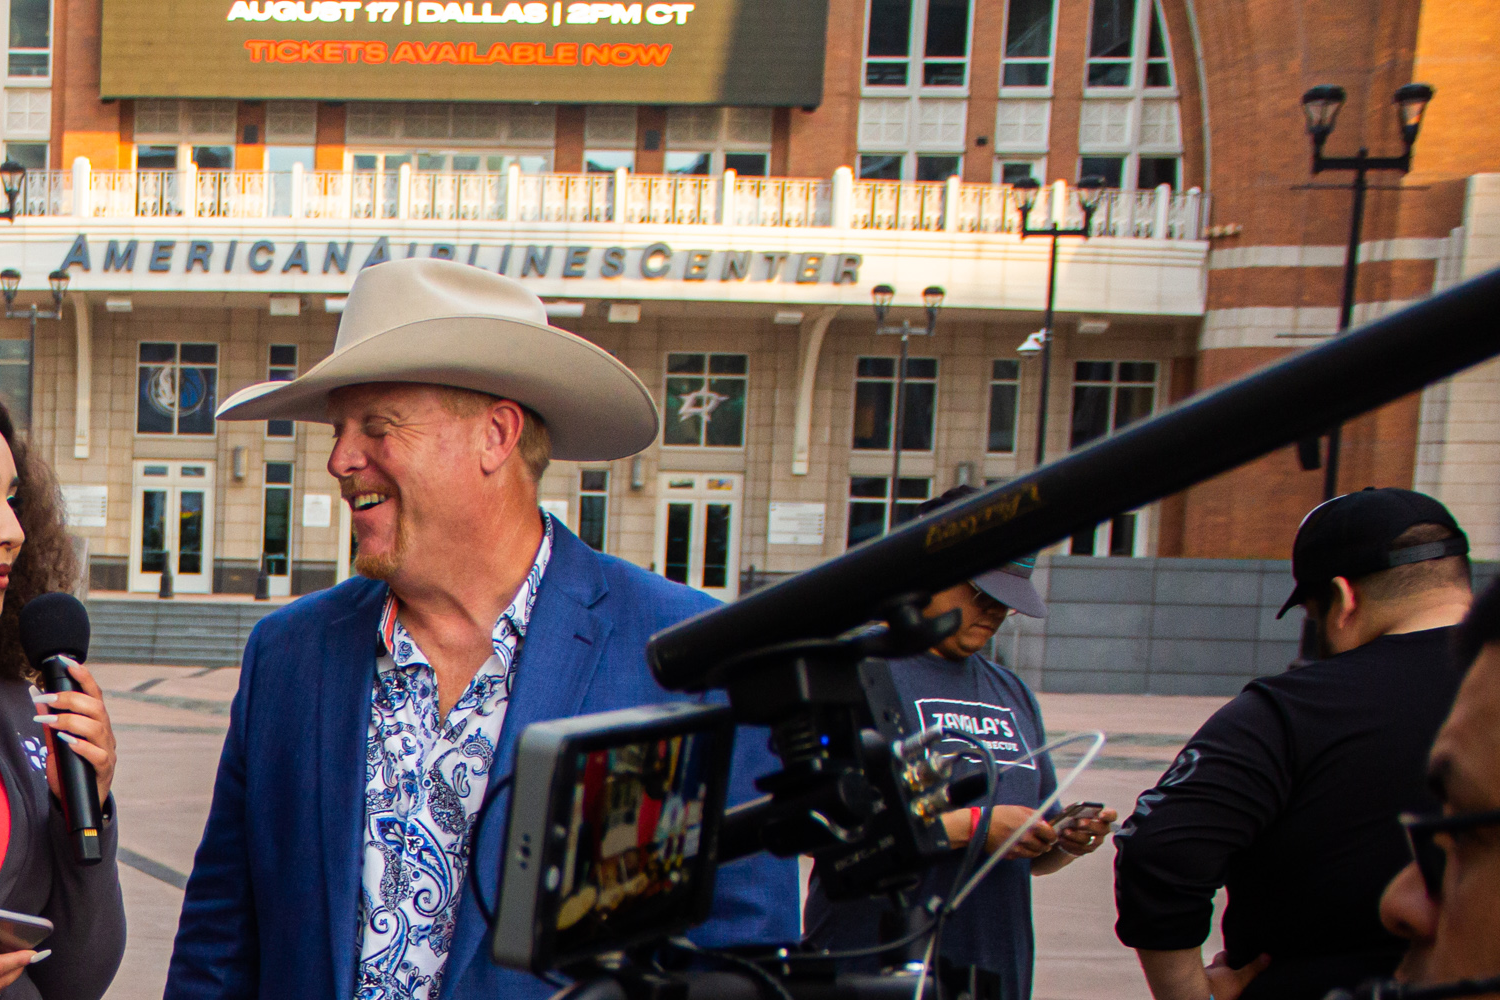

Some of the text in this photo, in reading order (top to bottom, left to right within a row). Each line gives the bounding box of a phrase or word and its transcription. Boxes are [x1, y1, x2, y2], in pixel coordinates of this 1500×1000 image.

[226, 0, 362, 22] AUGUST
[364, 1, 400, 22] 17
[417, 1, 548, 24] DALLAS
[566, 2, 642, 25] 2PM
[645, 3, 696, 25] CT
[243, 39, 673, 67] TICKETS AVAILABLE NOW
[61, 233, 355, 273] AMERICAN
[640, 240, 865, 285] CENTER
[970, 739, 1019, 752] BECUE
